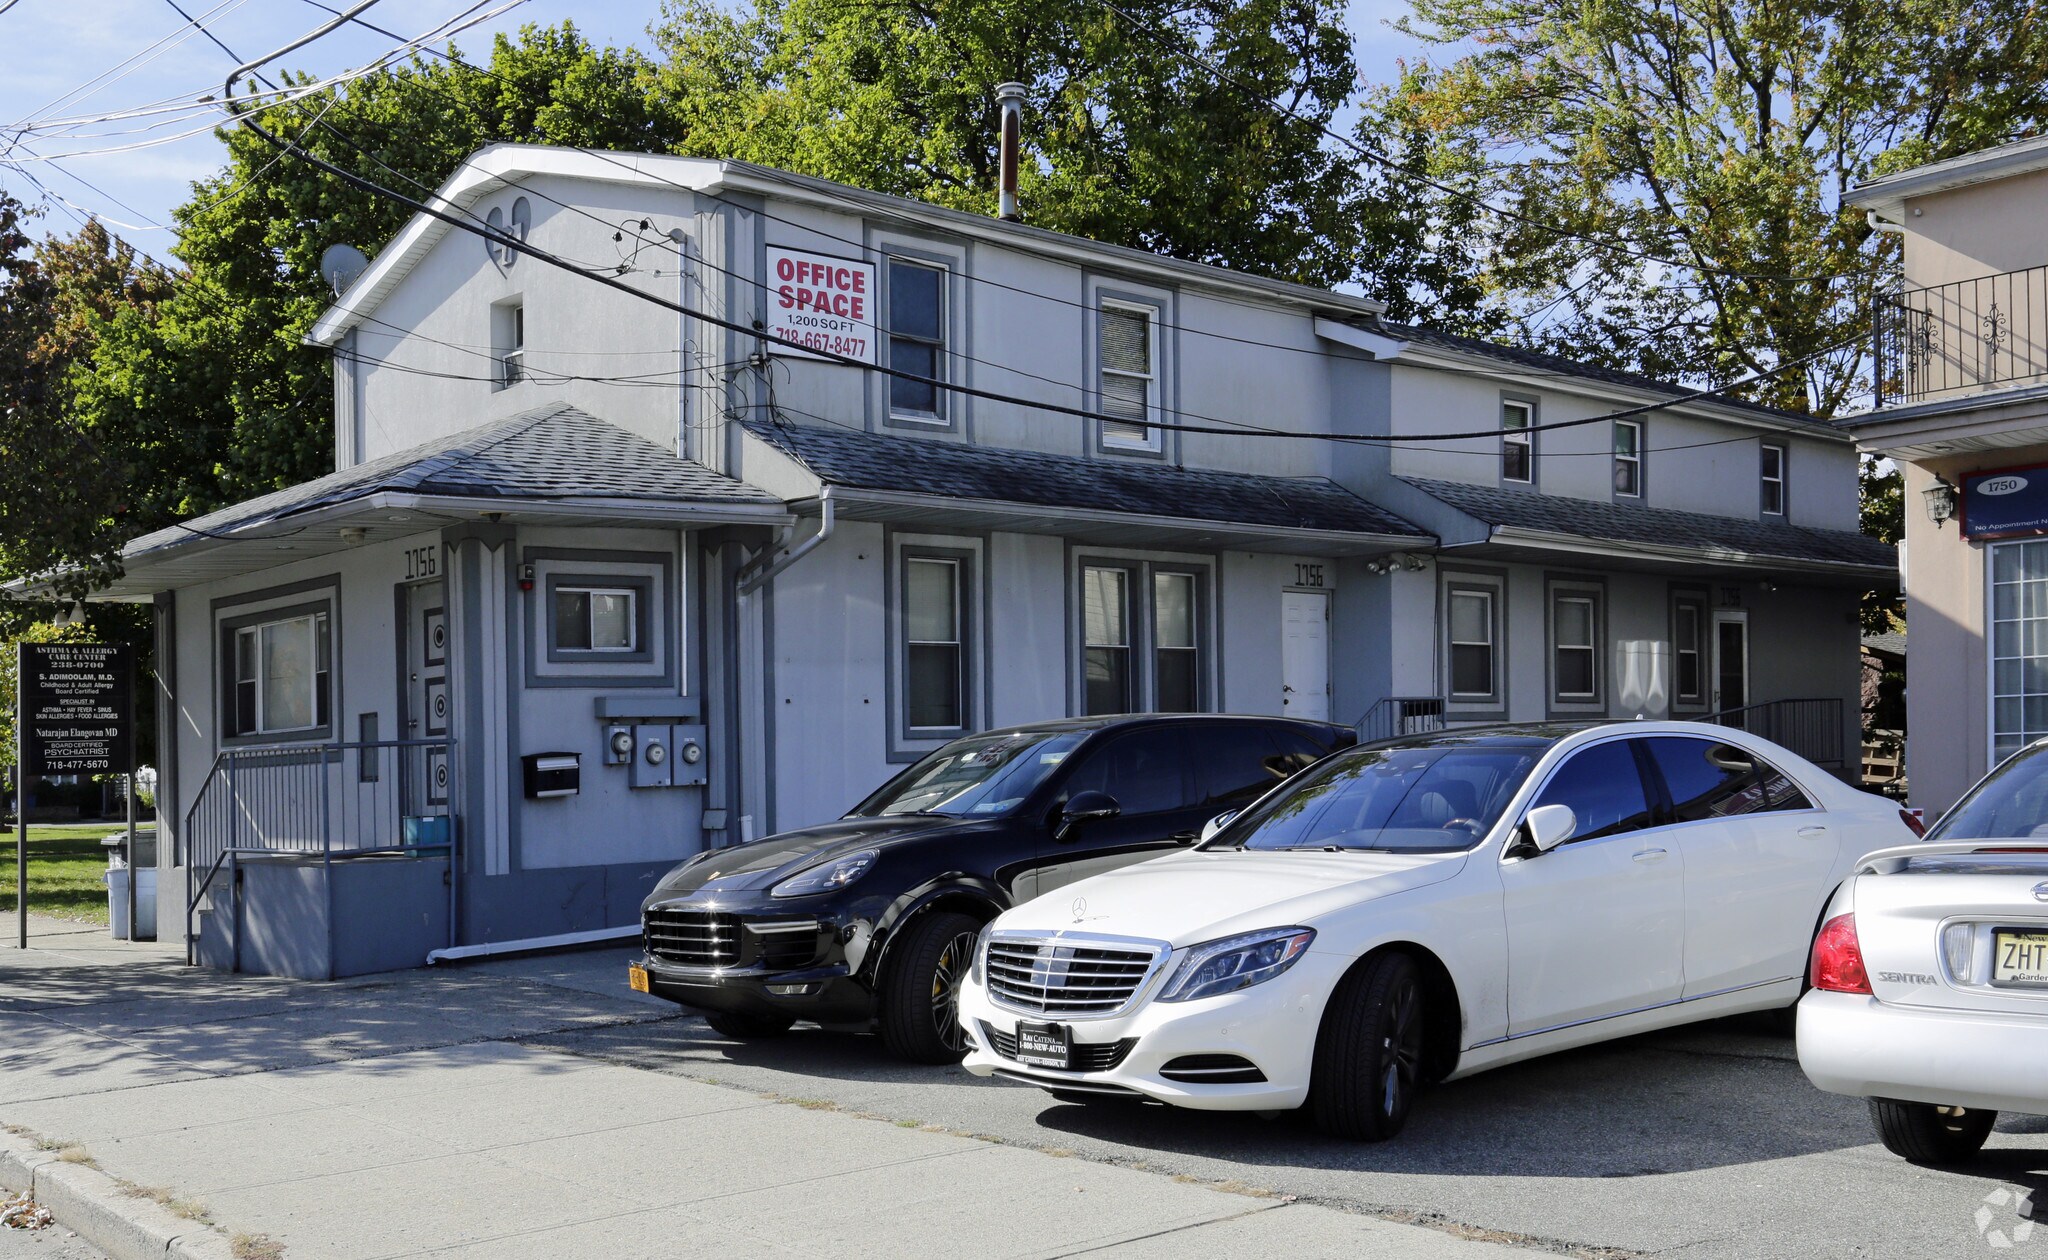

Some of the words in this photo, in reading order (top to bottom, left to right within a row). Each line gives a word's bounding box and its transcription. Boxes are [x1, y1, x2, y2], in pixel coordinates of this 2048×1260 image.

[776, 257, 865, 294] OFFICE
[778, 285, 864, 320] SPACE
[788, 314, 818, 327] 1,200
[820, 318, 838, 331] SQ
[840, 321, 855, 332] FT
[776, 327, 866, 357] 718-667-8477
[1988, 480, 2017, 492] 1750
[1988, 519, 2039, 530] Appointment
[404, 545, 436, 580] 1756
[1294, 563, 1323, 587] 1756
[36, 646, 70, 654] ASTHMA
[81, 647, 118, 655] ALLERGY
[48, 653, 71, 661] CARE
[73, 653, 106, 661] CENTER
[49, 673, 96, 681] ADIMOOLAM,
[36, 728, 69, 739] Natarajan
[70, 728, 104, 739] Elangovan
[105, 728, 118, 737] MD
[44, 748, 110, 756] PSYCHIATRIST
[47, 760, 108, 769] 718-477-5670
[1877, 971, 1939, 986] SENTRA
[1019, 1041, 1066, 1053] 1-800-NEW-AUTO
